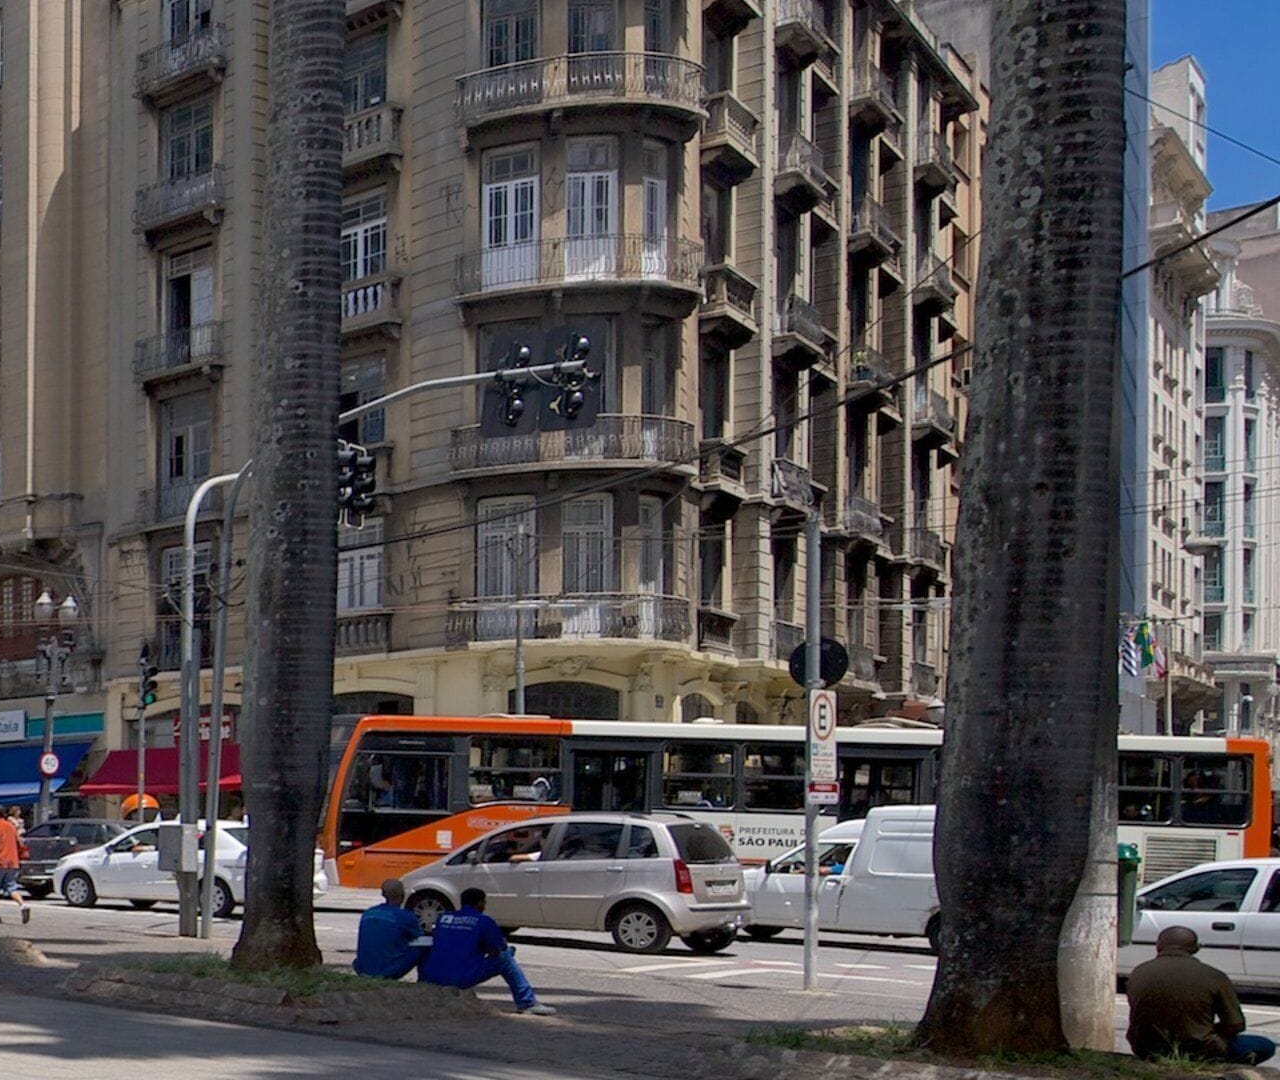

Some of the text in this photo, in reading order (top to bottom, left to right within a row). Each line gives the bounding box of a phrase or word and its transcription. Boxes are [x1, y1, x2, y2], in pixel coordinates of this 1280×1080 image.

[819, 703, 827, 731] E
[44, 758, 56, 768] 40
[739, 826, 795, 836] PREFEITURA
[738, 837, 765, 846] SÃO
